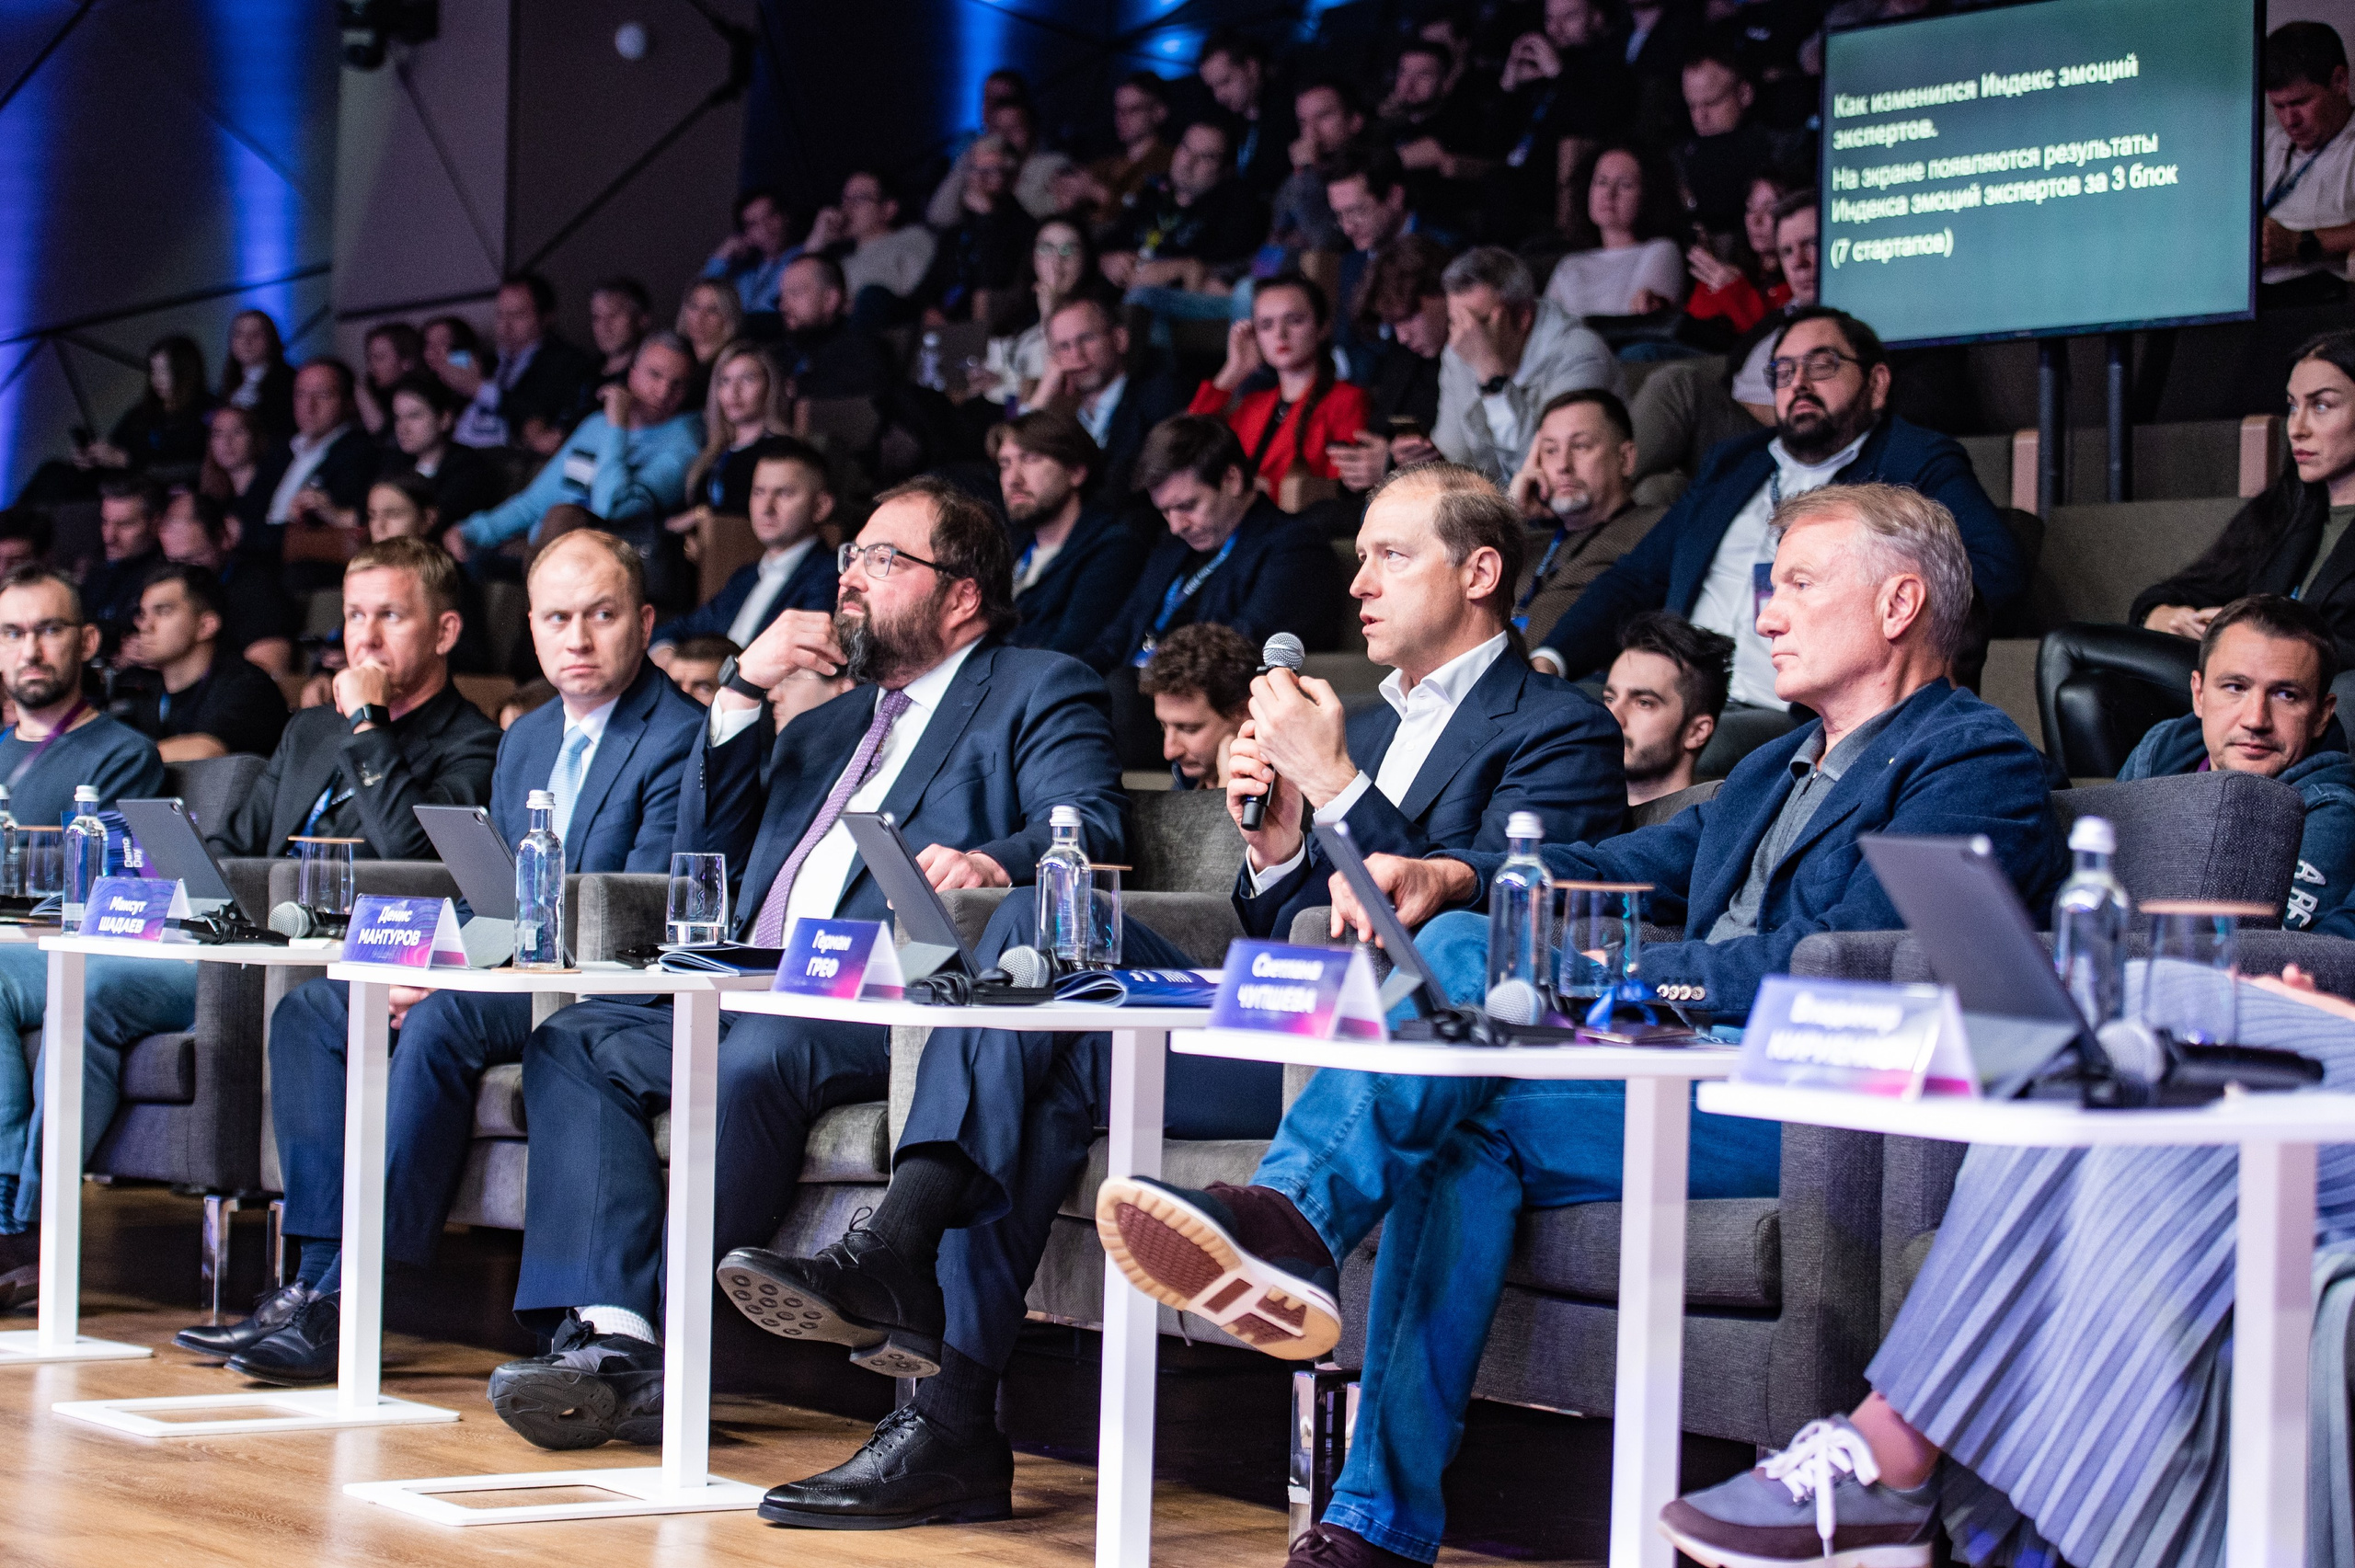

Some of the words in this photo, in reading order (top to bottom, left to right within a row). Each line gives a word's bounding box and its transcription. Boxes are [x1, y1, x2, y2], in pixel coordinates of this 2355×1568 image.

[1833, 93, 1869, 119] Как
[1870, 79, 1977, 114] изменился
[1981, 69, 2055, 97] Индекс
[2058, 52, 2139, 84] эмоций
[1832, 118, 1938, 150] экспертов.
[1832, 166, 1859, 191] На
[1861, 160, 1926, 190] экране
[1928, 146, 2040, 179] появляются
[2044, 132, 2158, 171] результаты
[1831, 196, 1909, 223] Индекса
[1910, 182, 1982, 213] эмоций
[1983, 175, 2082, 205] экспертов
[2084, 172, 2108, 194] за
[2111, 165, 2126, 190] 3
[2129, 162, 2178, 189] блок
[1830, 237, 1851, 269] (7
[1852, 226, 1954, 264] стартапов)
[121, 836, 134, 868] Demo
[132, 848, 145, 868] Day
[109, 896, 148, 916] Максут
[376, 905, 413, 924] Денис
[98, 915, 146, 934] ШАДАЕВ
[357, 928, 421, 946] МАНТУРОВ
[811, 929, 853, 954] Герман
[805, 956, 840, 979] ГРЕФ
